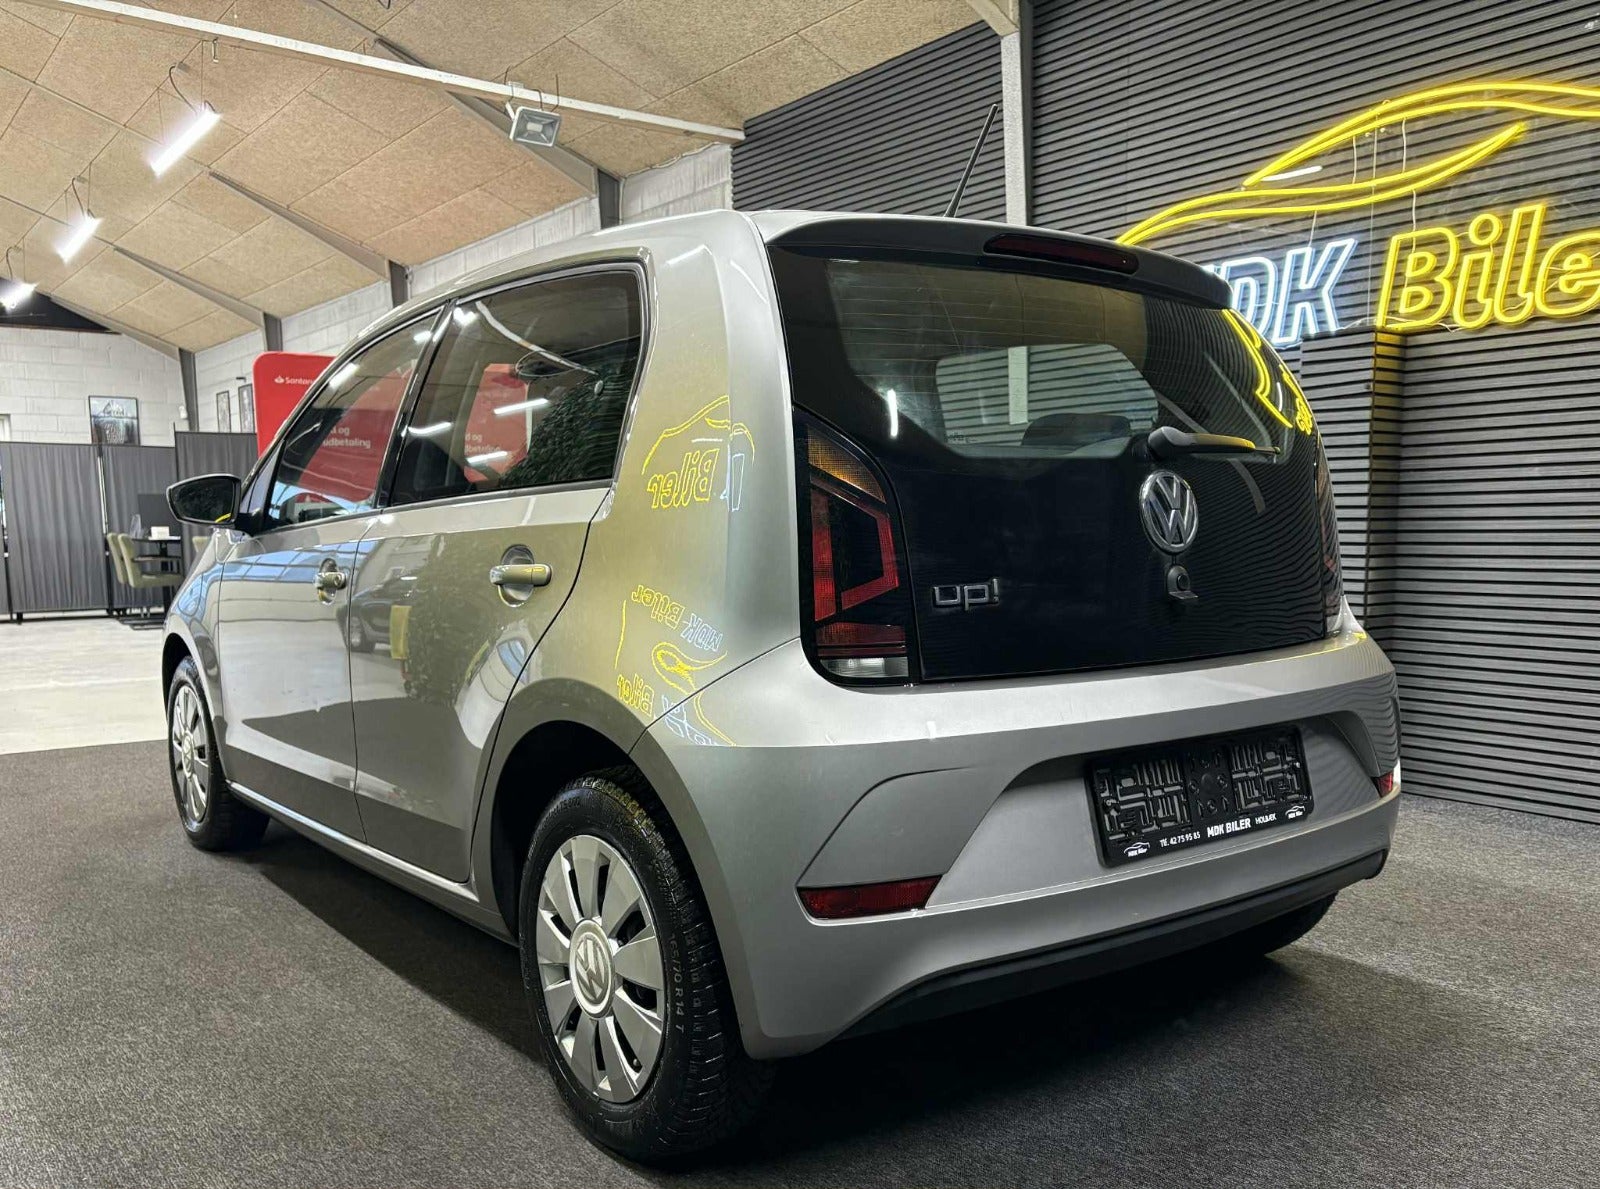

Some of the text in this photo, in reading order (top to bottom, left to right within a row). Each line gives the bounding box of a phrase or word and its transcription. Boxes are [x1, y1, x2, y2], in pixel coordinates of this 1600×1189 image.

[1200, 237, 1358, 348] DK
[338, 426, 350, 436] og
[933, 578, 999, 611] up!
[1207, 823, 1225, 838] MDK
[1225, 818, 1251, 834] BILER
